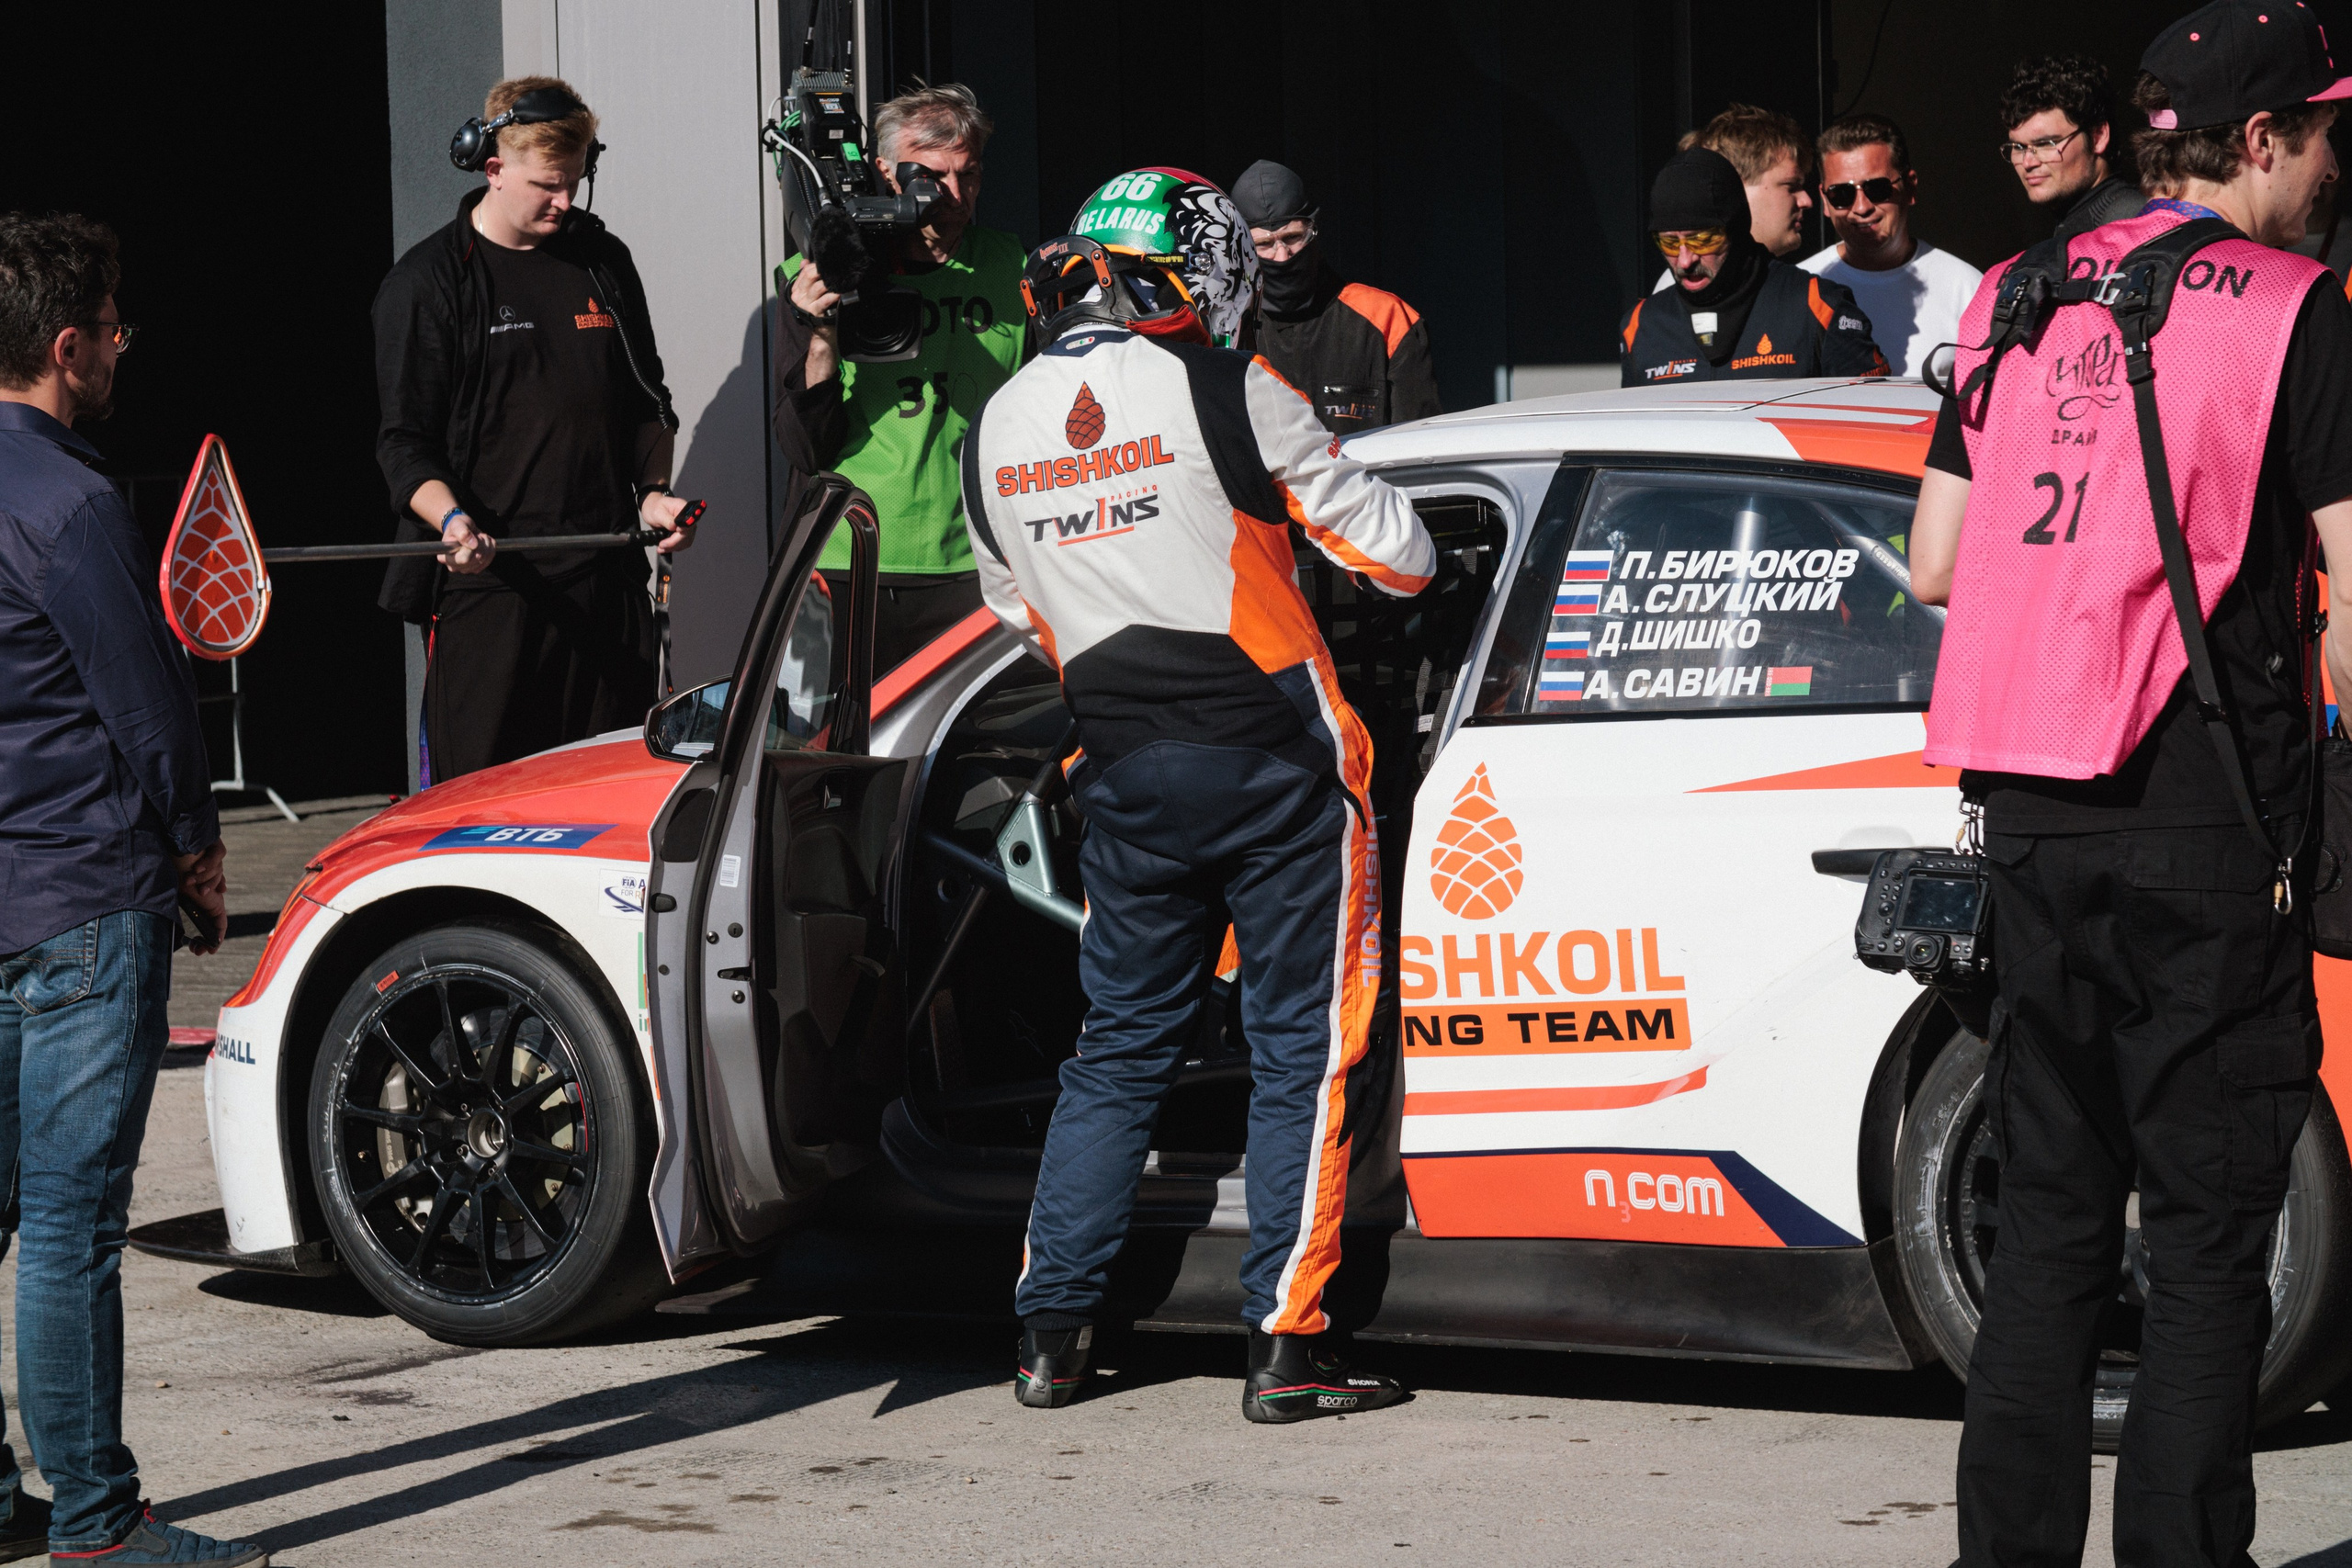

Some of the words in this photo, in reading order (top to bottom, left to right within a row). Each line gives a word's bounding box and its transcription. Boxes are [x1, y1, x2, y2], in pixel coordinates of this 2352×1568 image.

[1101, 173, 1162, 201] 66
[1076, 207, 1166, 235] BELARUS
[922, 296, 993, 337] OTO
[1731, 354, 1796, 370] SHISHKOIL
[995, 434, 1175, 497] SHISHKOIL
[2023, 471, 2090, 546] 21
[484, 828, 574, 842] ВТБ
[1507, 1008, 1675, 1043] TEAM
[217, 1033, 256, 1065] SHALL
[1317, 1395, 1358, 1409] sparco
